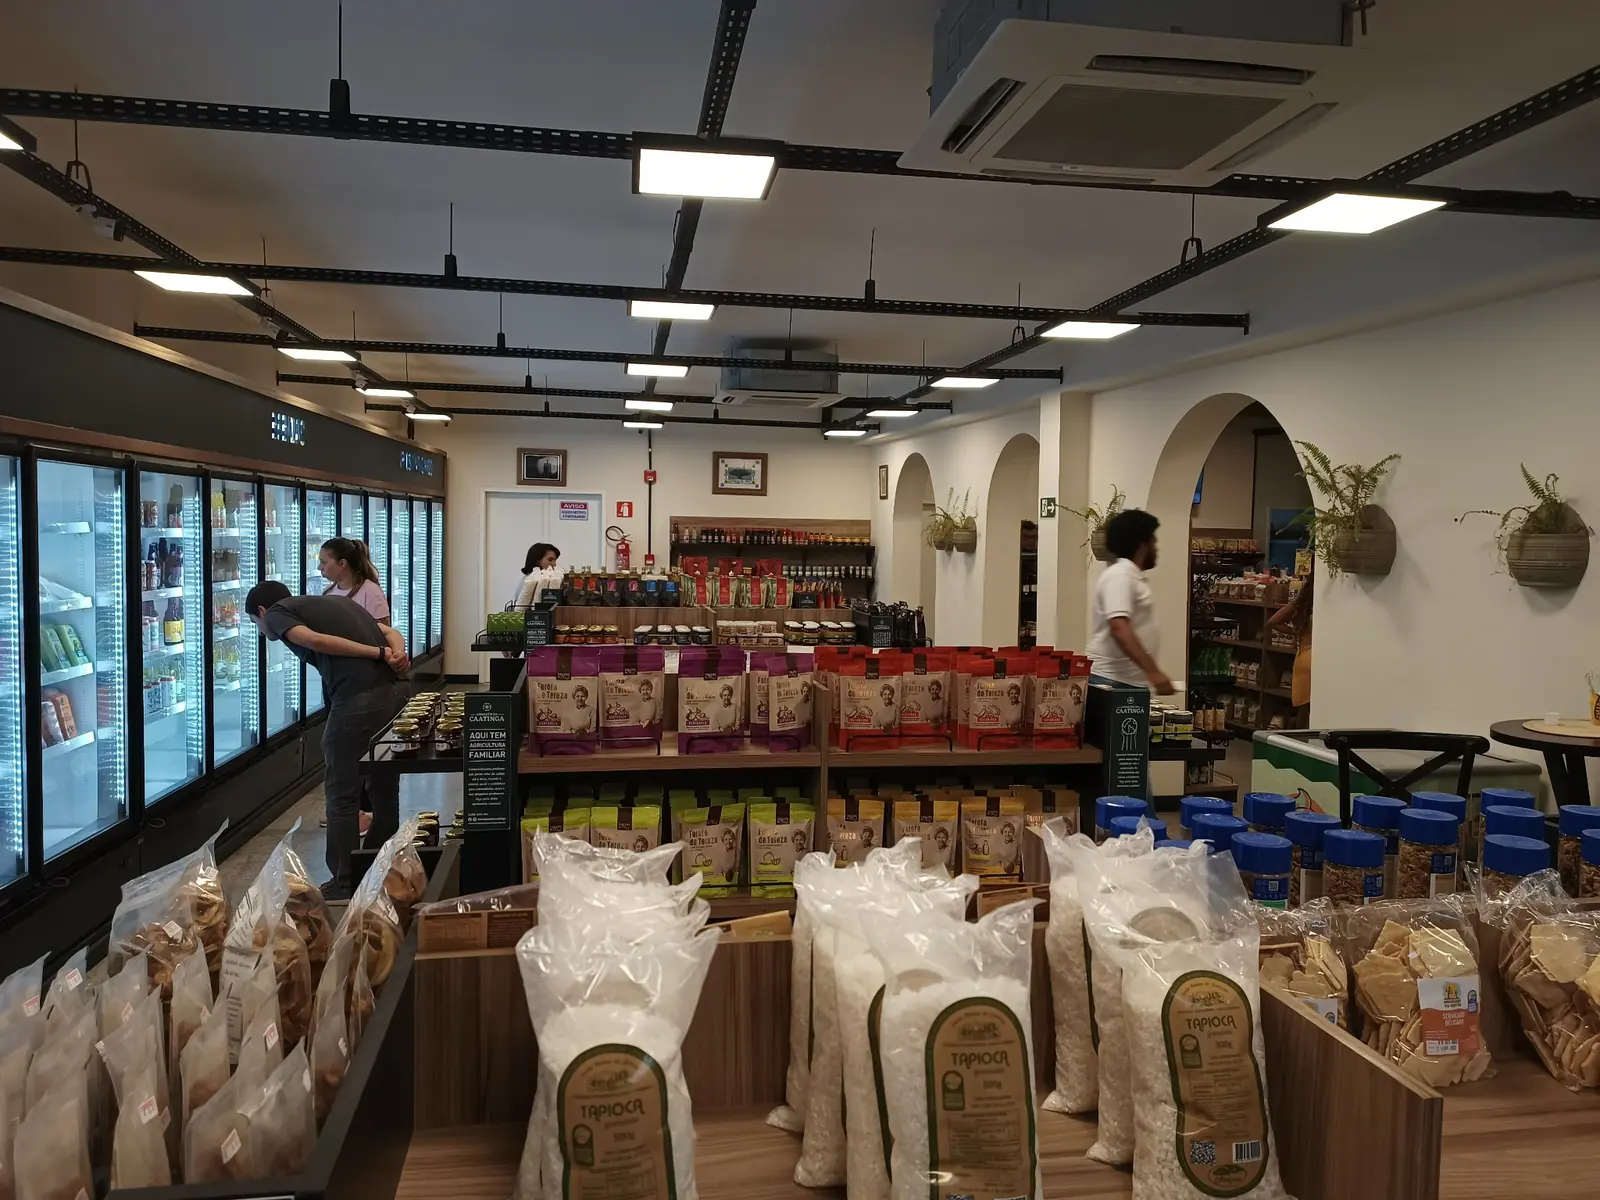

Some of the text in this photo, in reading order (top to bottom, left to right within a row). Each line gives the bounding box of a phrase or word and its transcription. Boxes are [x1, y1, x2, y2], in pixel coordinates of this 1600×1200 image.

[469, 731, 507, 739] AQUI TEM
[469, 751, 506, 760] FAMILIAR
[1185, 1015, 1237, 1032] TAPIOCA
[951, 1051, 1011, 1070] TAPIOCA
[580, 1098, 646, 1122] TAPIOCA
